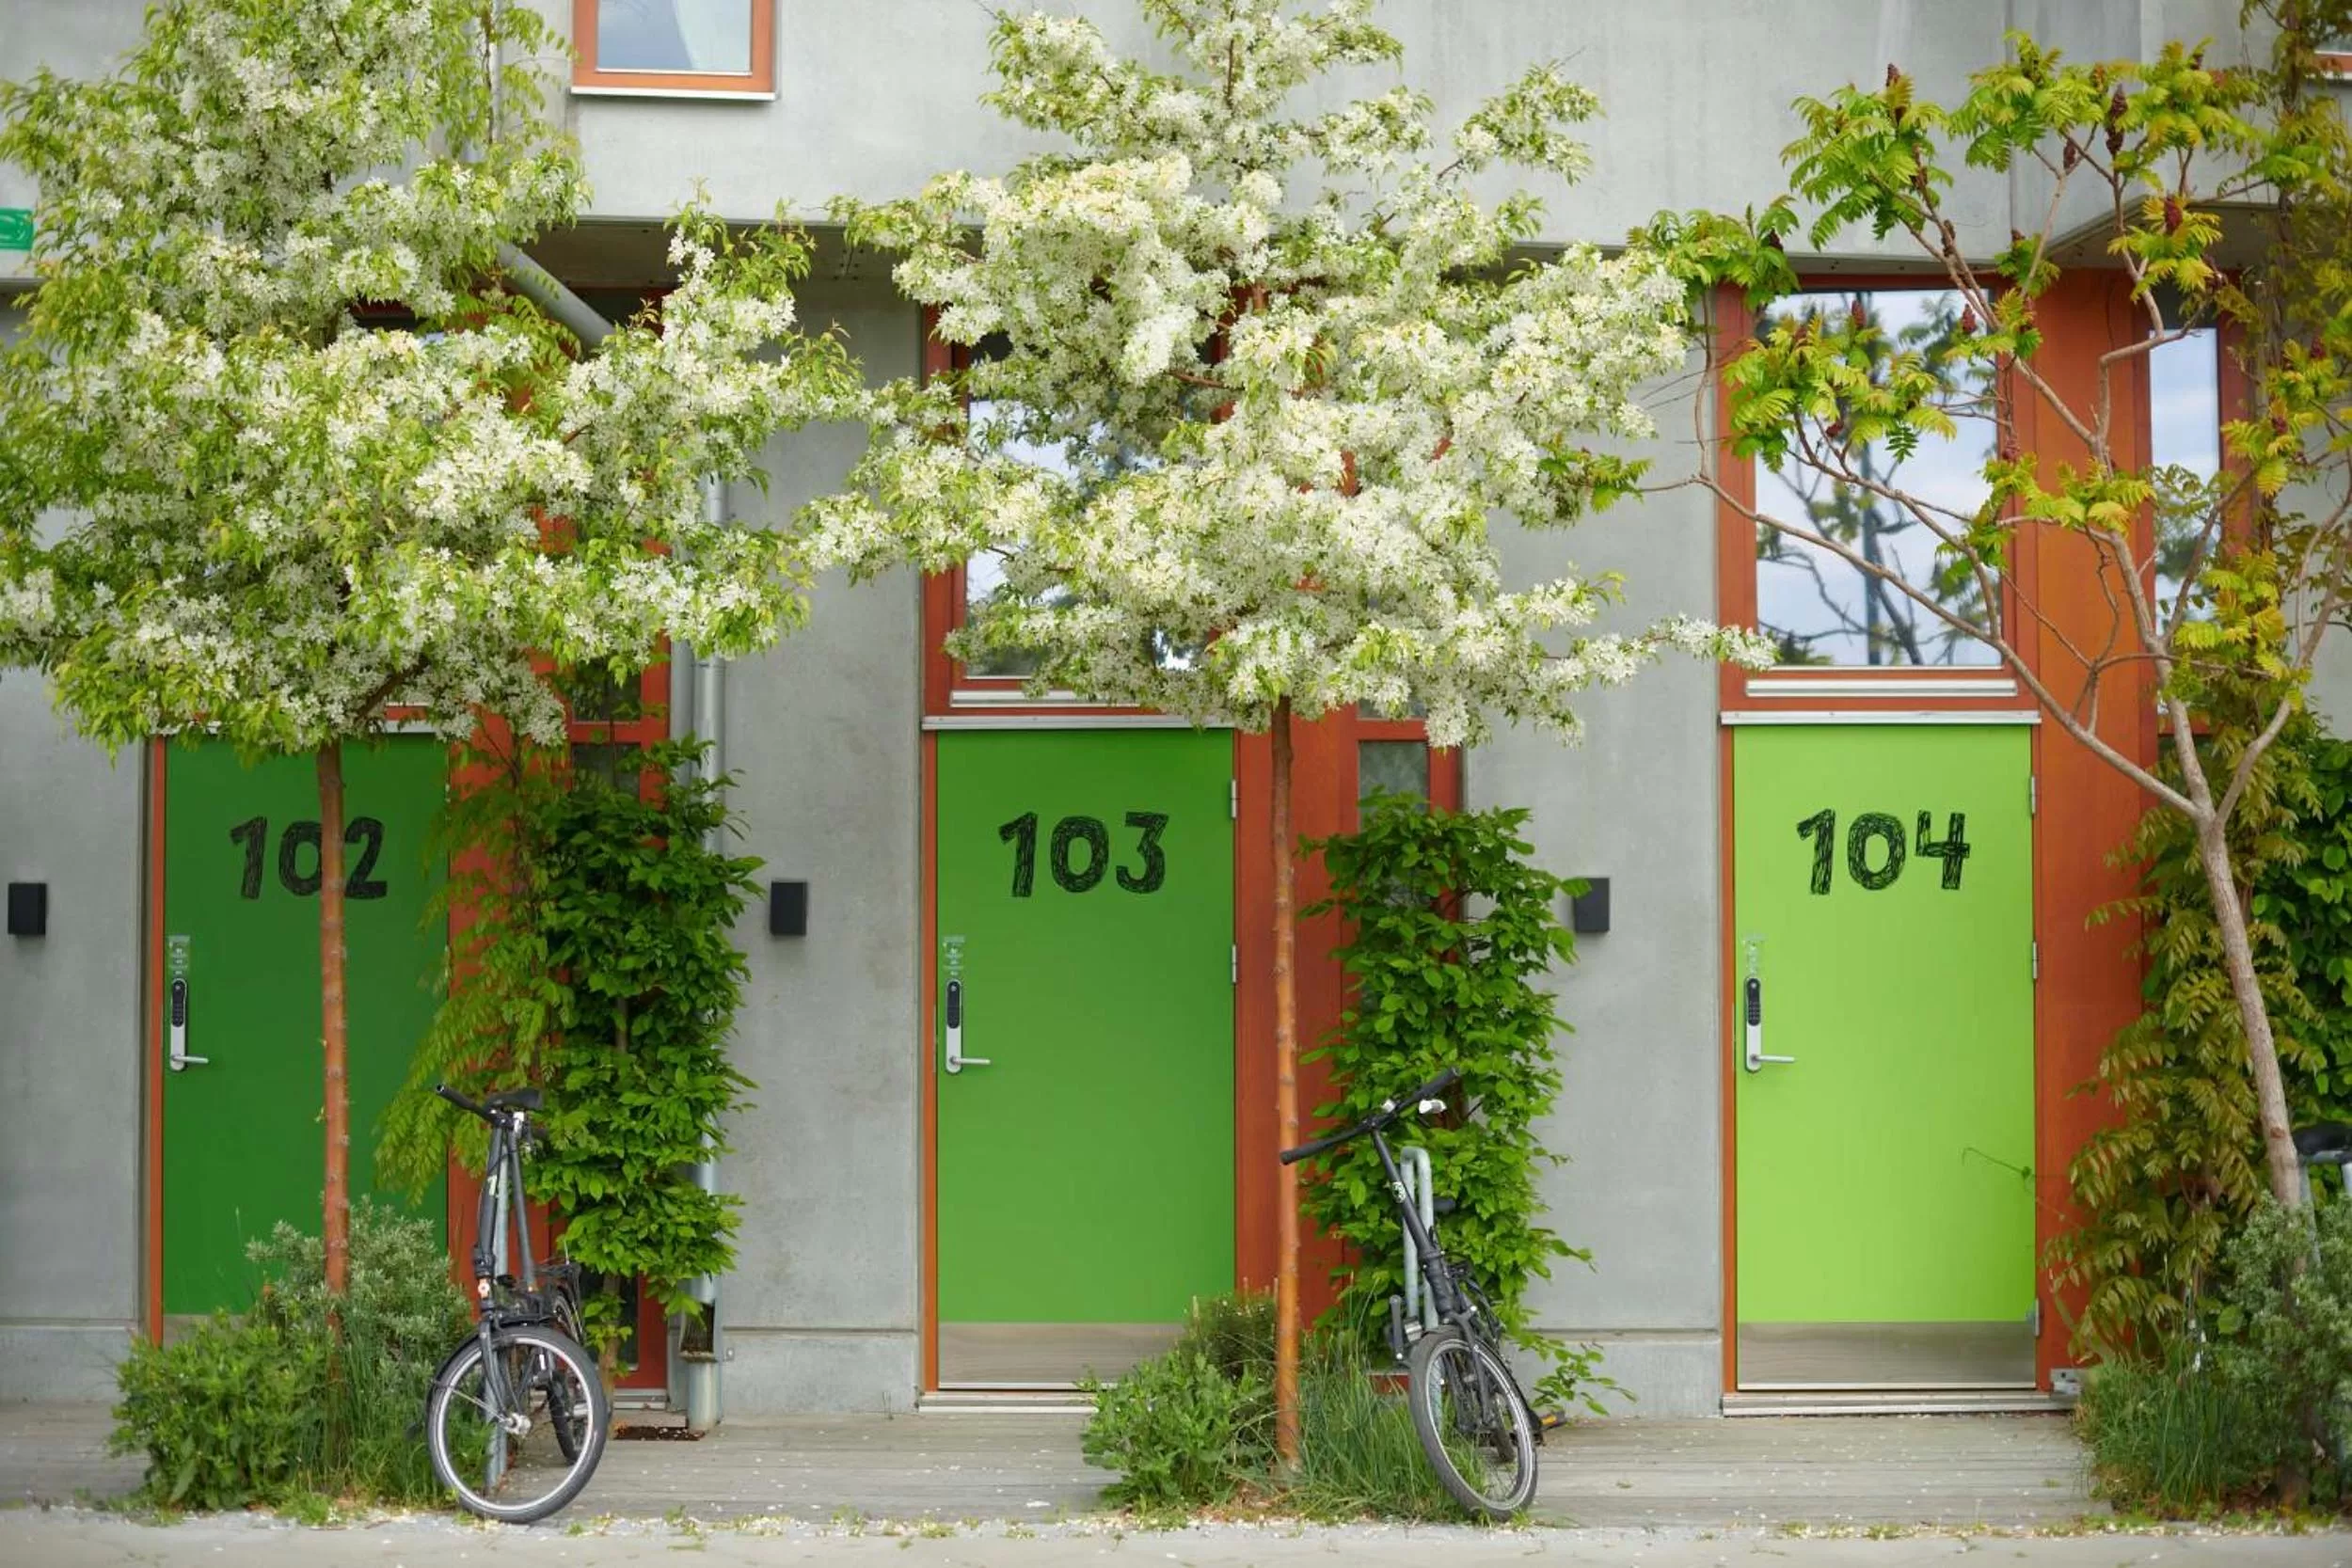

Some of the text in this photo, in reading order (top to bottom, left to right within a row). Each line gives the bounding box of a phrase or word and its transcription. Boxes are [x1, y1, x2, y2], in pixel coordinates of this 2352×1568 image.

[229, 815, 389, 900] 102
[998, 811, 1169, 897] 103
[1796, 808, 1971, 895] 104
